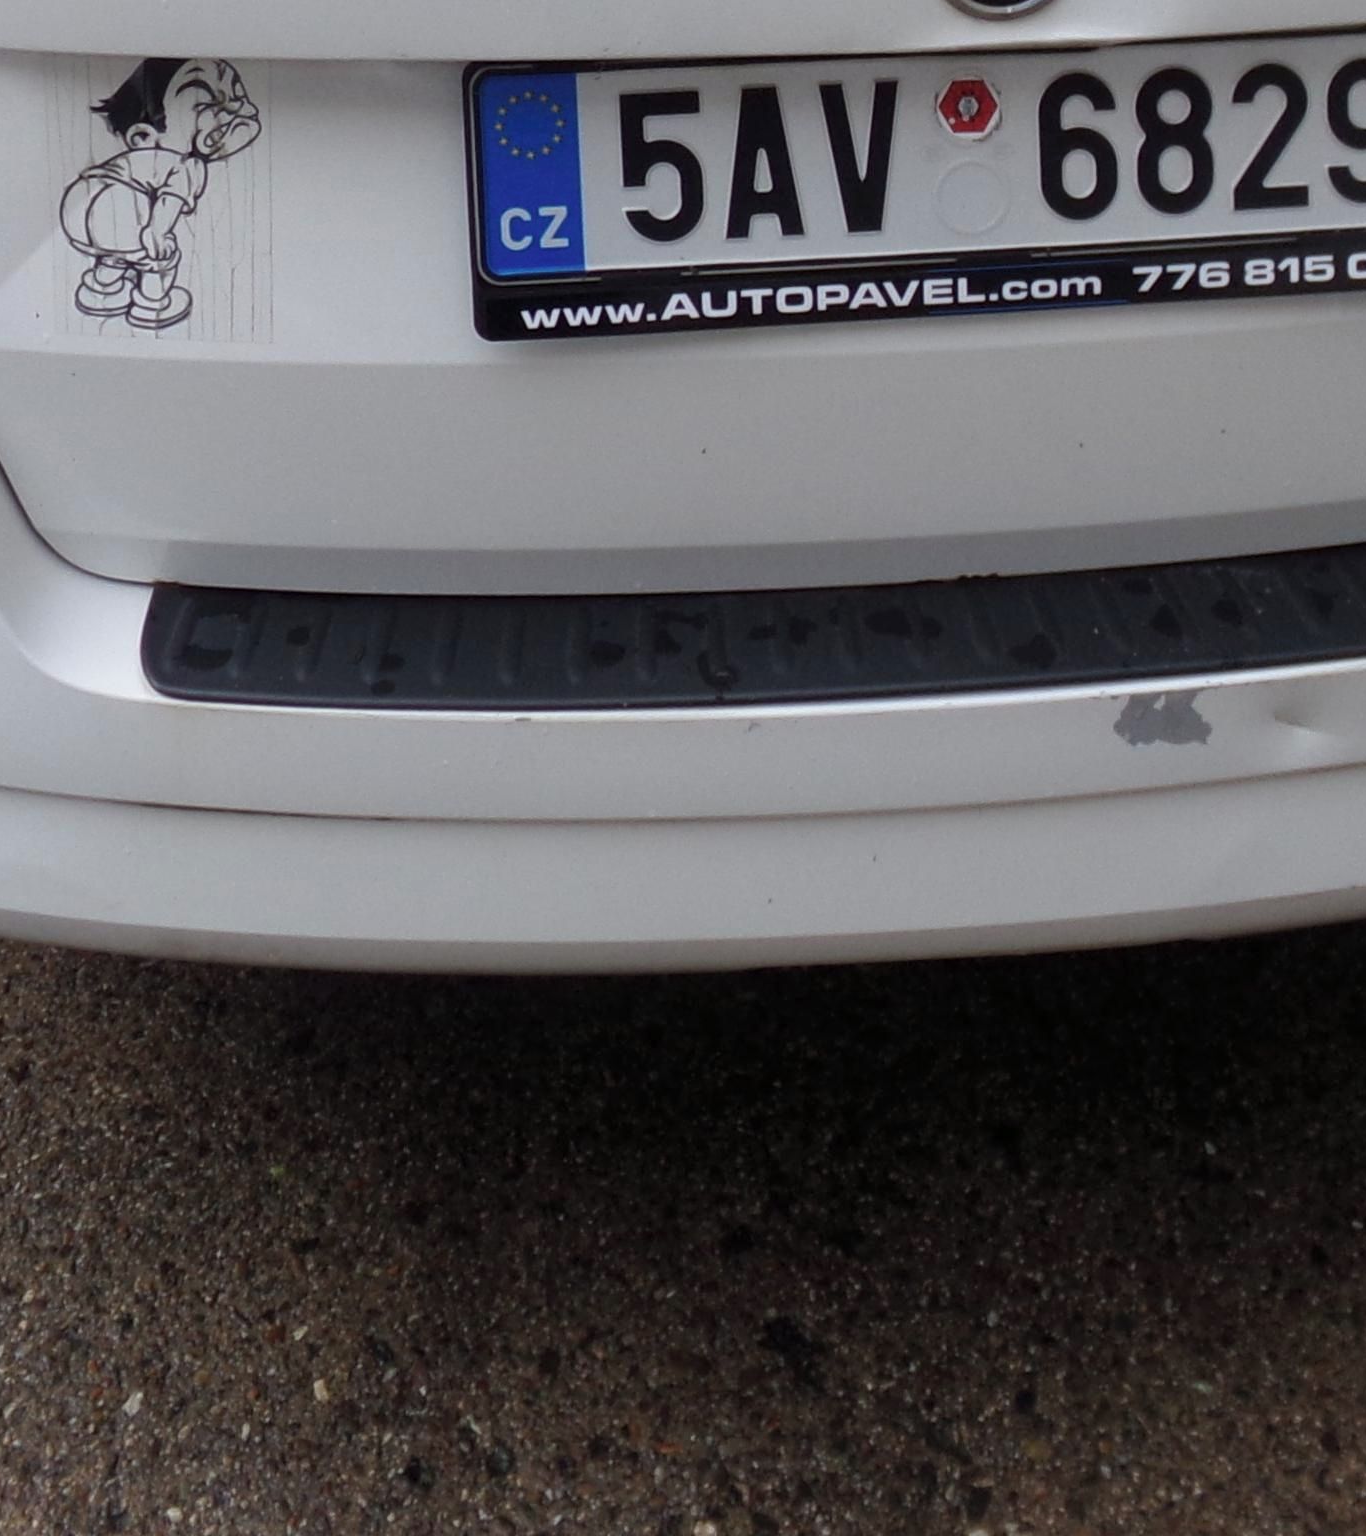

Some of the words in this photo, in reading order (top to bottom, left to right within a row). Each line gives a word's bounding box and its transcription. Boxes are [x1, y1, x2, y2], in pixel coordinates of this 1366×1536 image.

[619, 80, 898, 242] 5AV
[500, 205, 570, 251] CZ
[520, 274, 1102, 330] www.AUTOPAVEL.com
[1132, 261, 1231, 293] 776
[1243, 254, 1335, 287] 815
